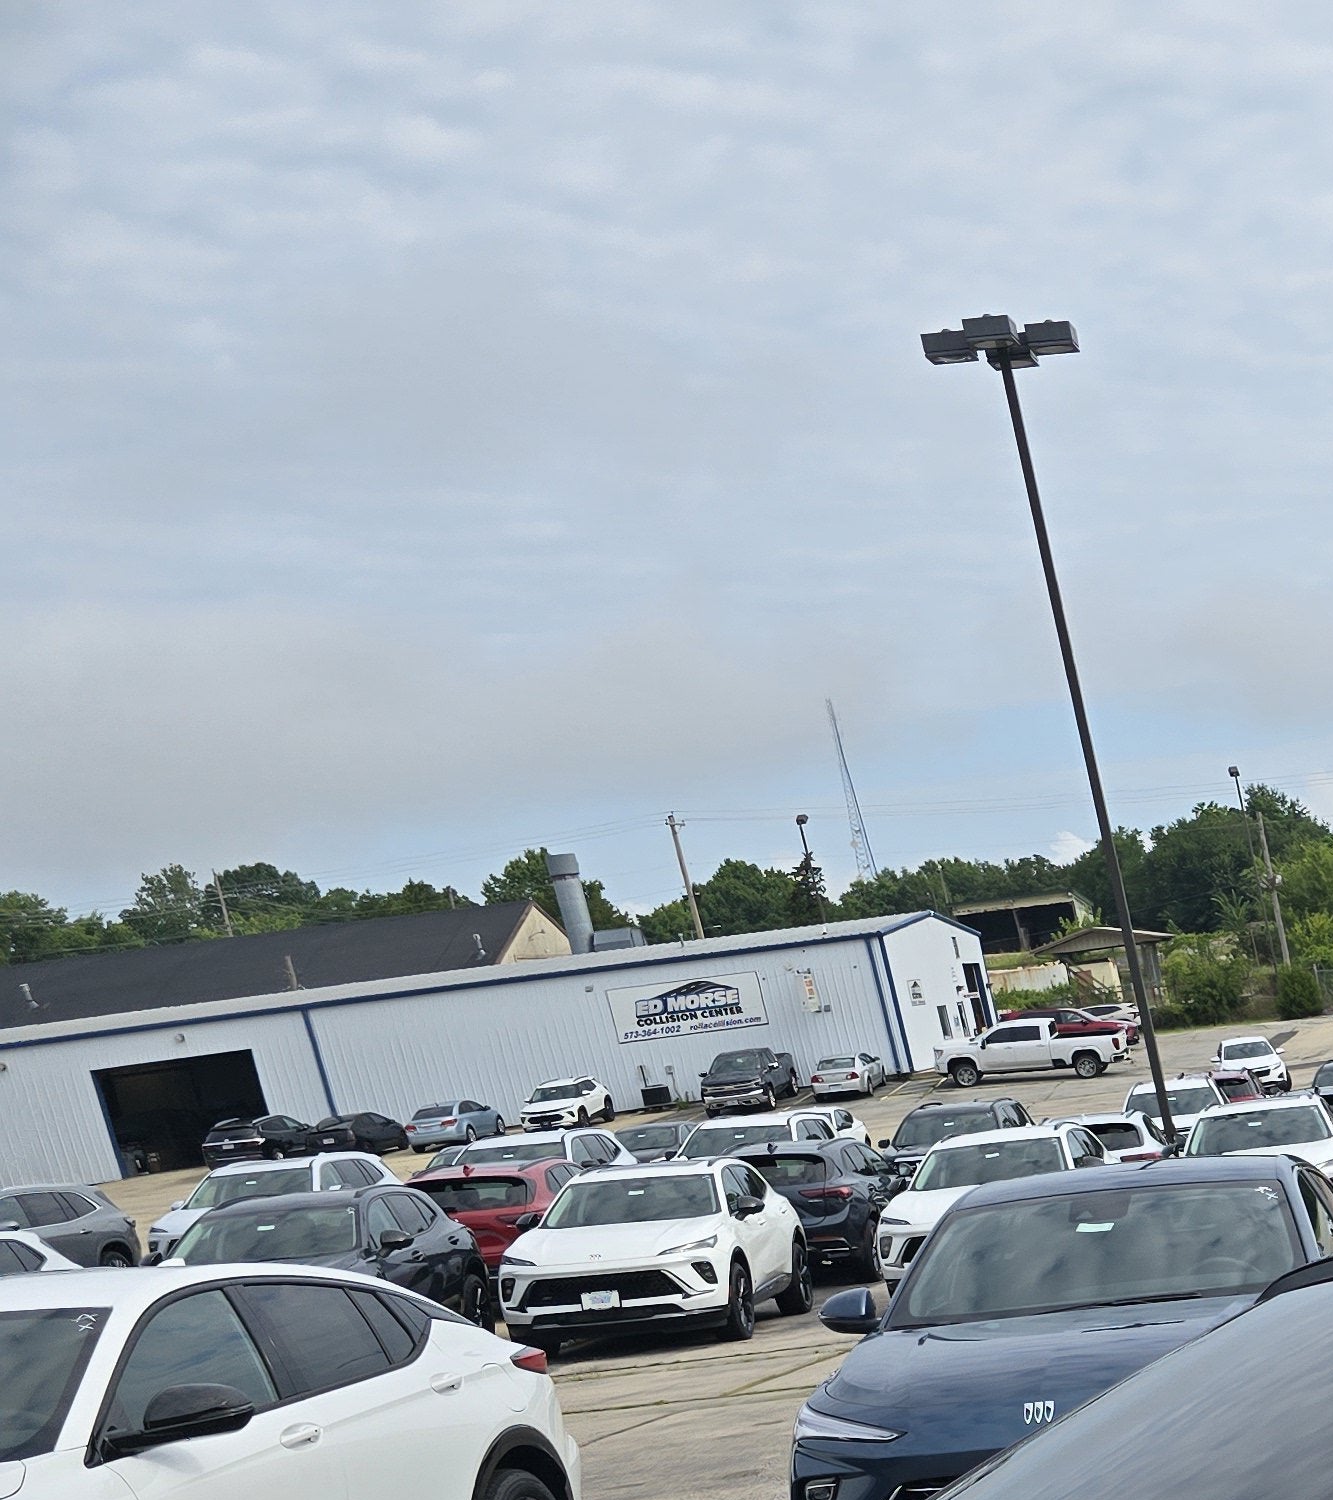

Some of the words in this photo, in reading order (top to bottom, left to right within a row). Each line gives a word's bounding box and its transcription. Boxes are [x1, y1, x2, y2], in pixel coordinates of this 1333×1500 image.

[636, 1000, 664, 1015] ED
[666, 988, 740, 1013] MORSE
[636, 1010, 699, 1028] COLLISION
[701, 1005, 744, 1019] CENTER
[623, 1024, 682, 1040] 573-364-1002
